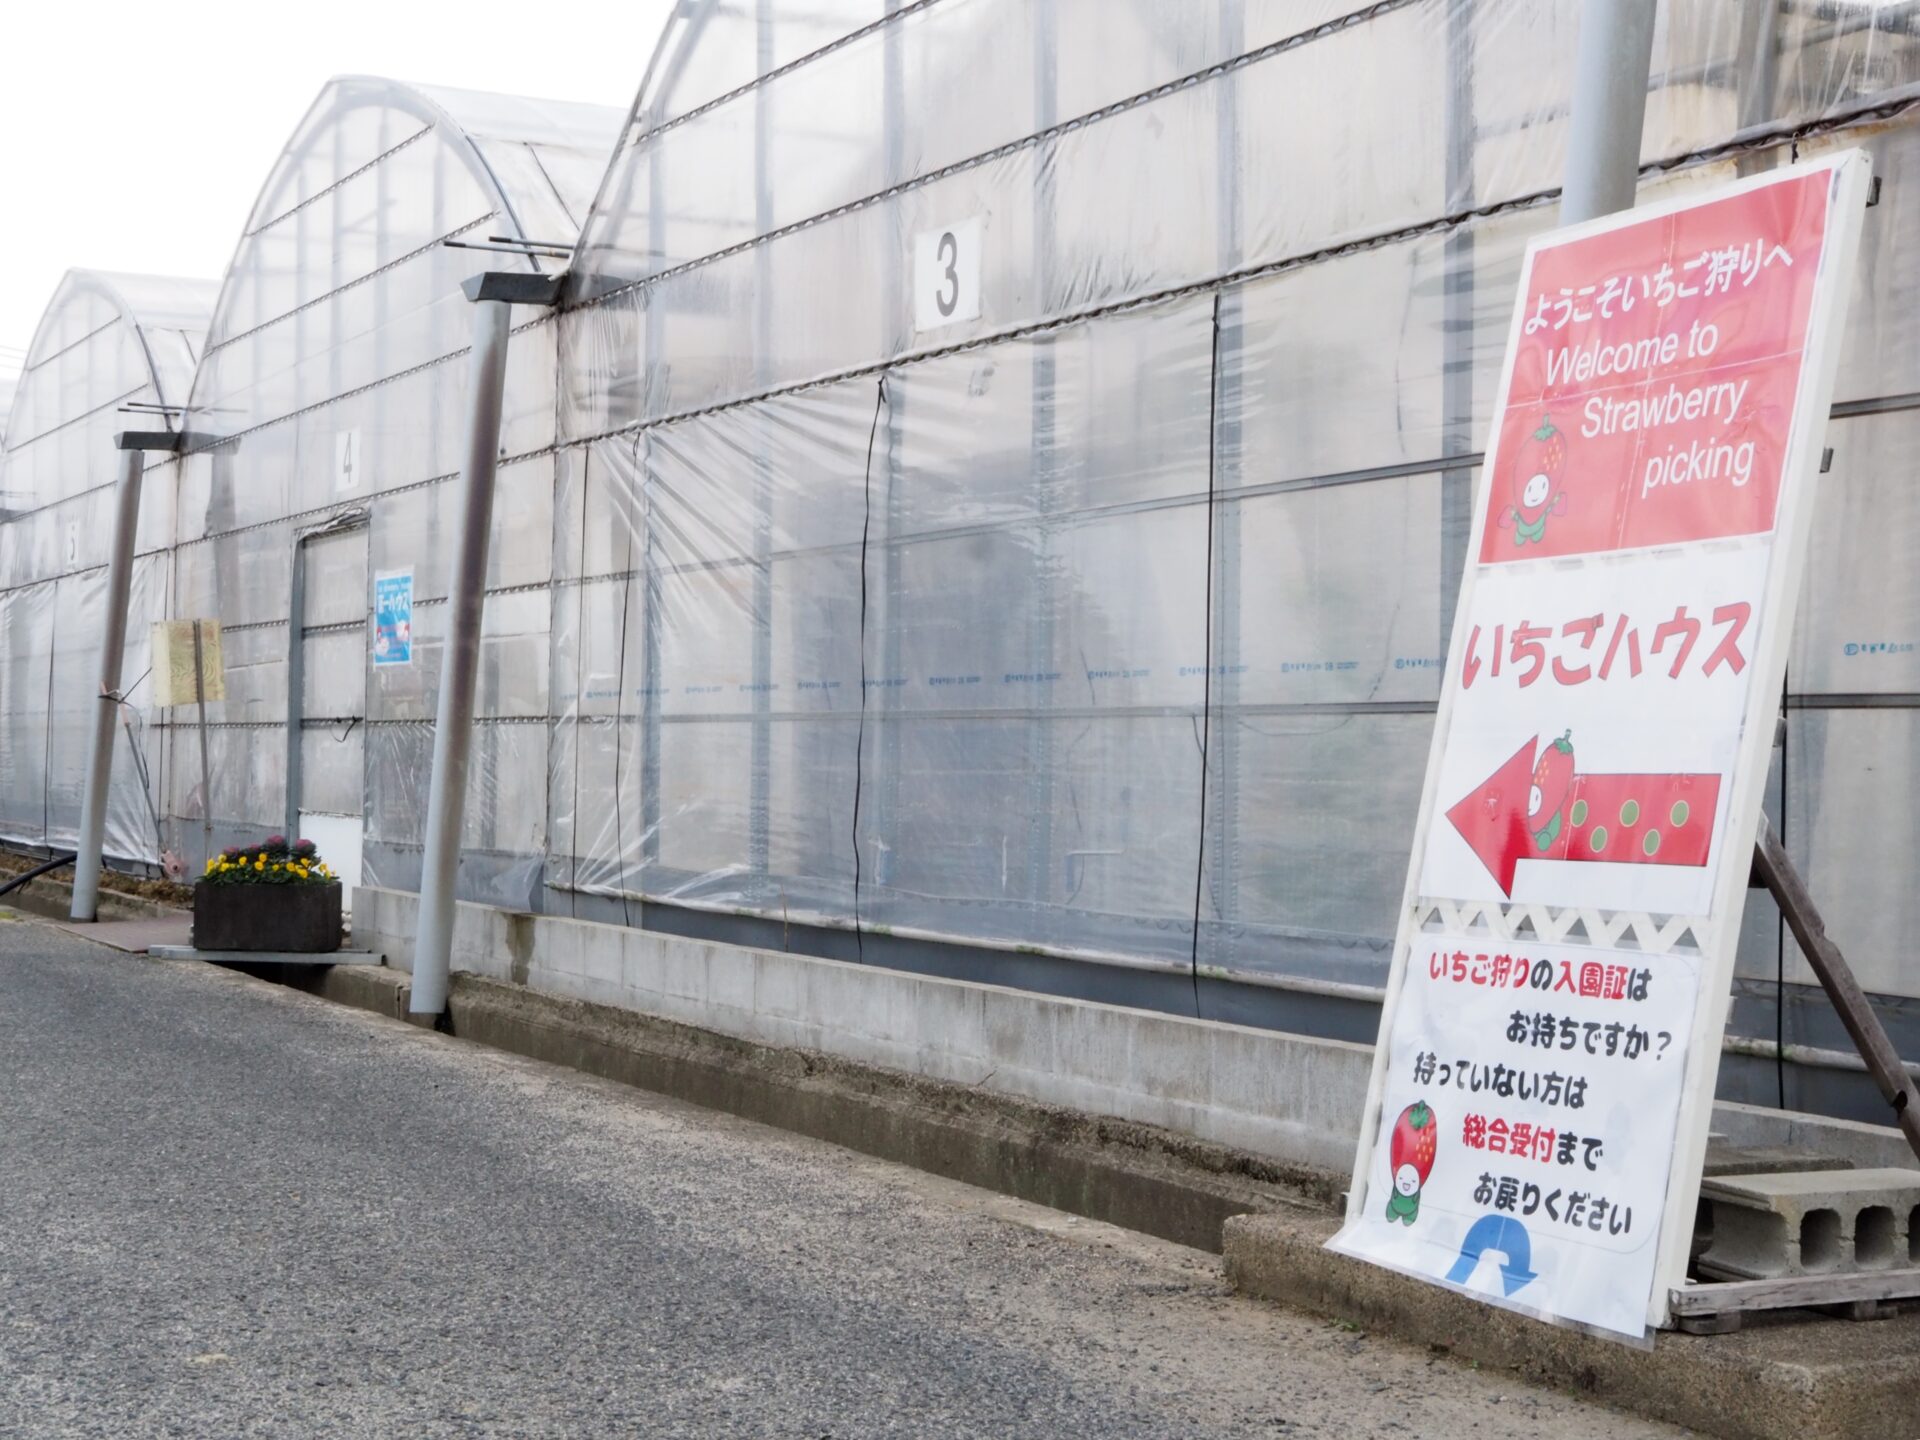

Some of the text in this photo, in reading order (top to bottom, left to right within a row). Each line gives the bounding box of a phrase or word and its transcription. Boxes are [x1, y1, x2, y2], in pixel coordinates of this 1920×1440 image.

[936, 231, 959, 317] 3
[1525, 238, 1793, 335] ようこそいちご狩りへ
[1545, 319, 1719, 386] Welcome to
[1581, 380, 1749, 438] Strawberry
[343, 432, 353, 484] 4
[1641, 437, 1755, 499] picking
[1462, 601, 1751, 689] いちごハウス
[1430, 951, 1652, 1001] いちご狩りの入園証は
[1413, 1051, 1588, 1108] 持っていない方は
[1462, 1113, 1603, 1171] 総合受付まで
[1473, 1172, 1632, 1235] お戻りください
